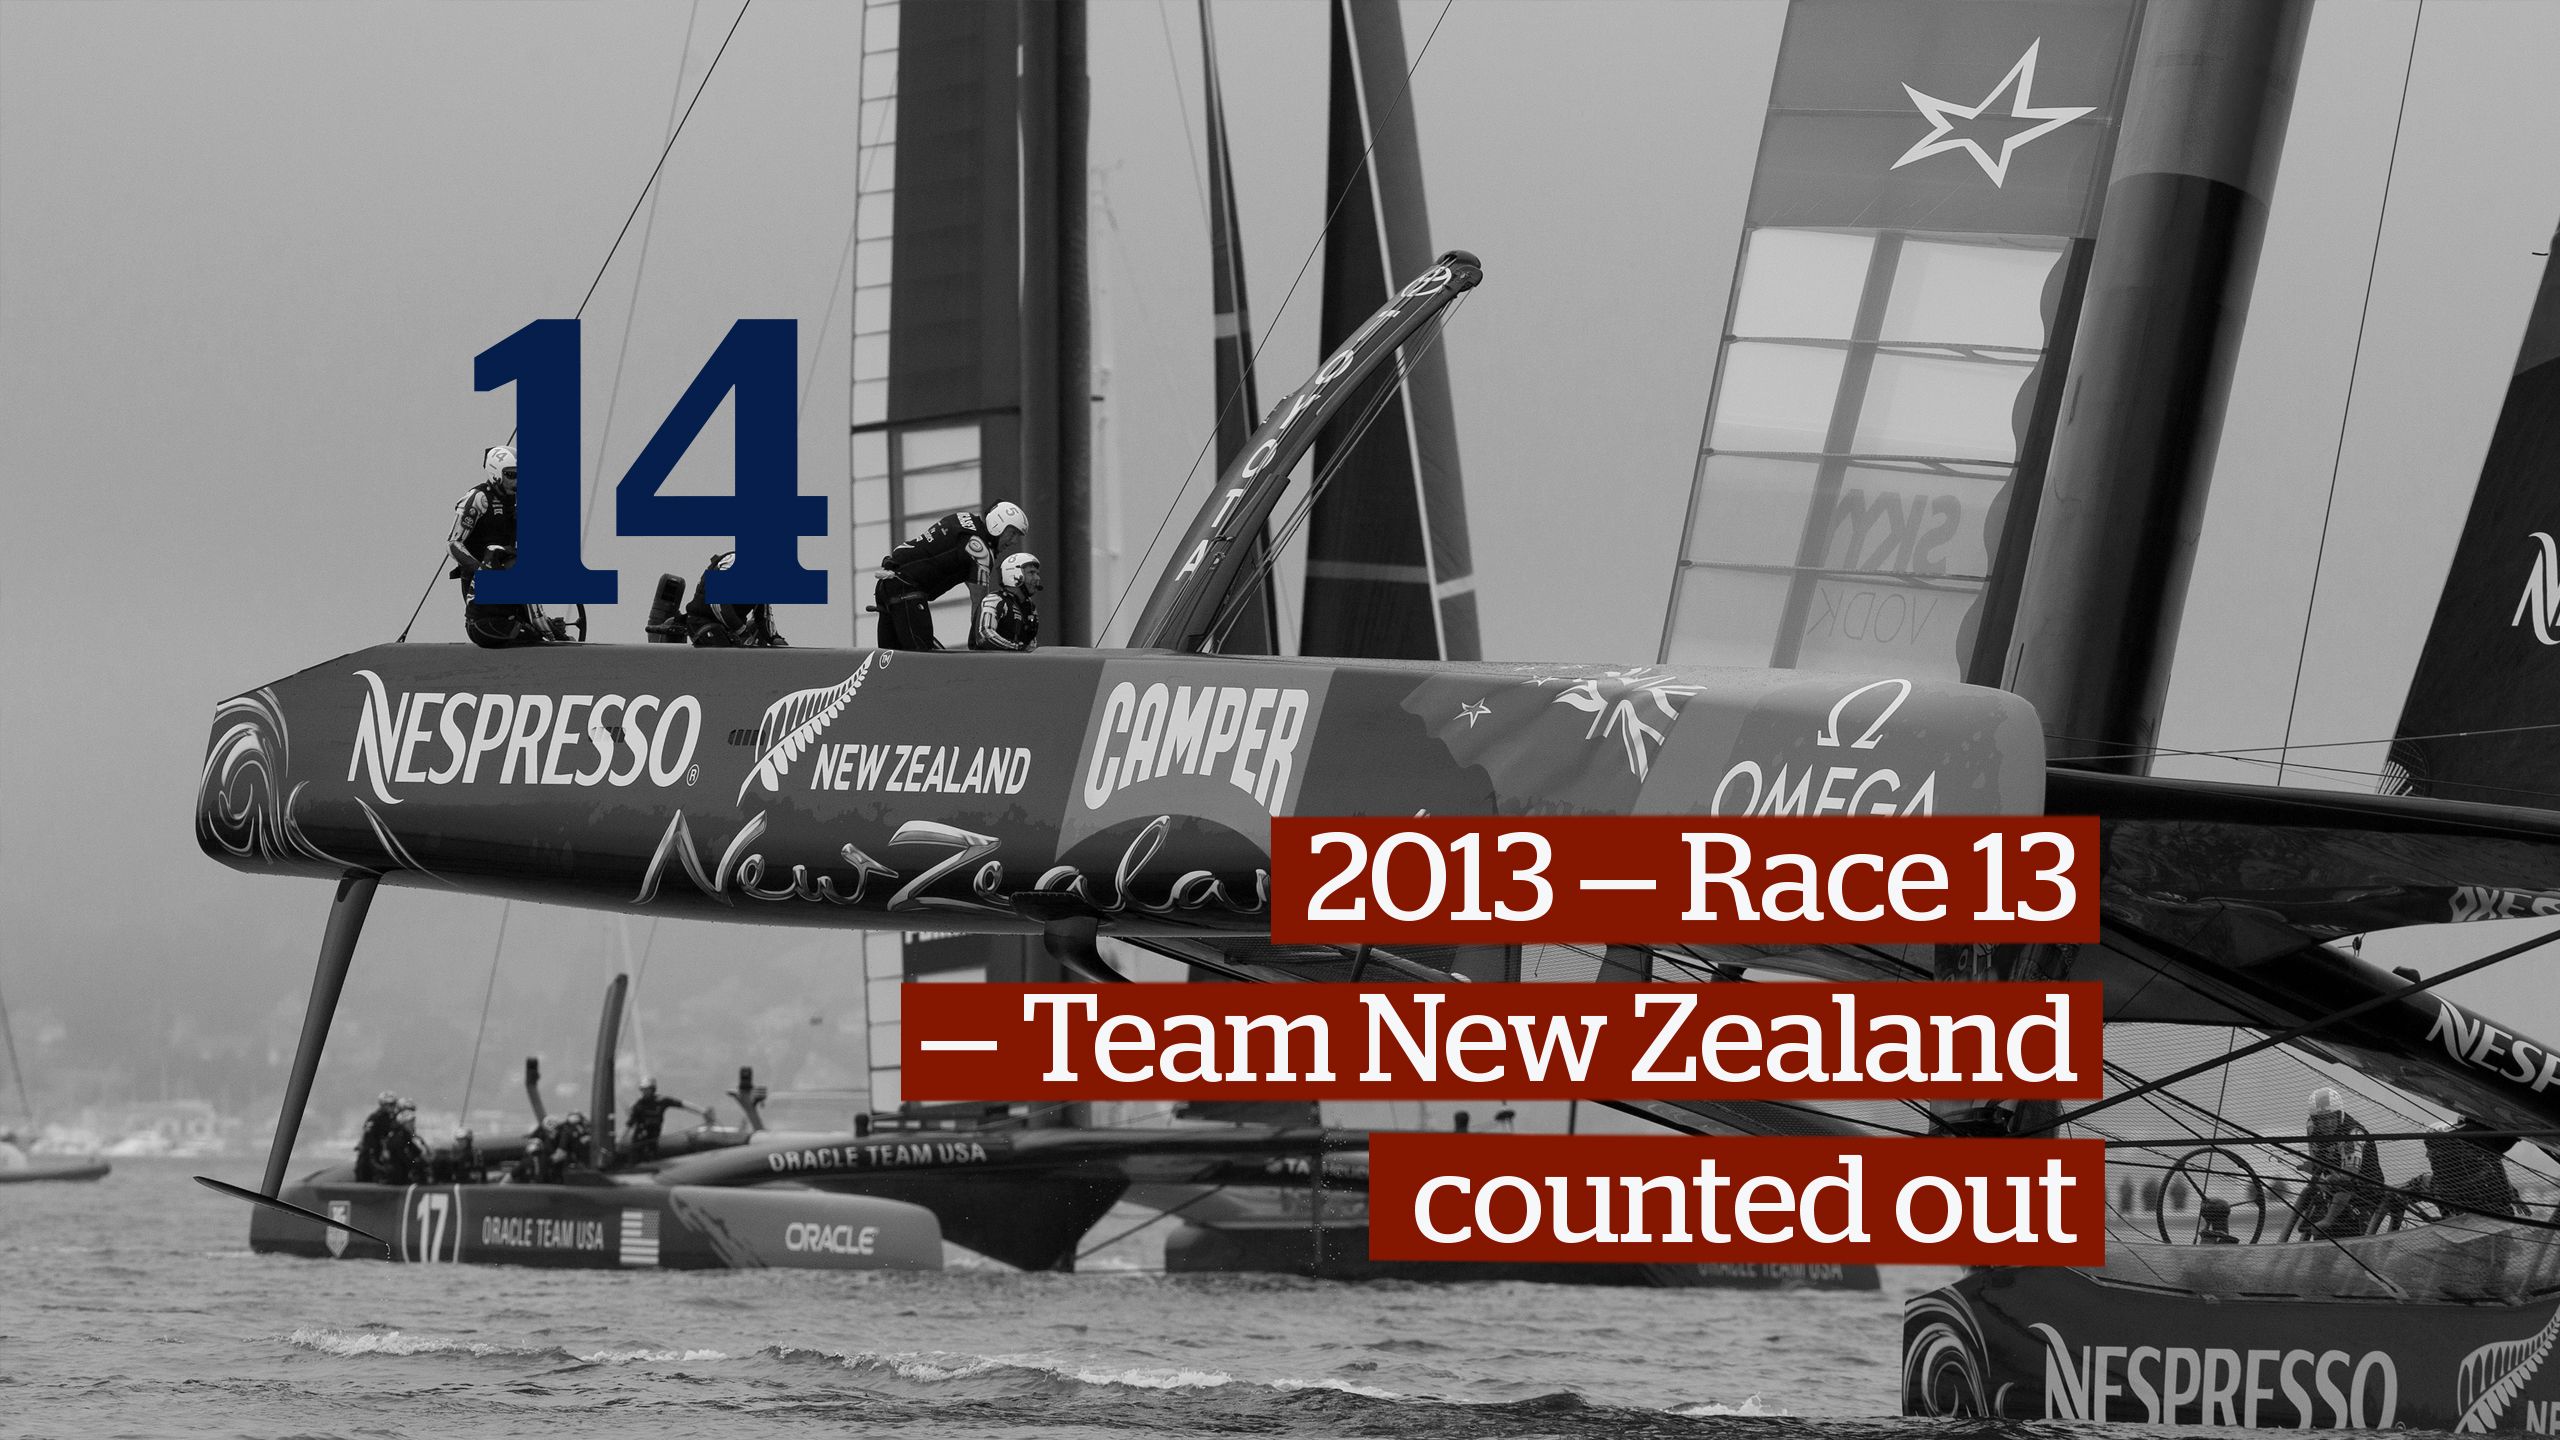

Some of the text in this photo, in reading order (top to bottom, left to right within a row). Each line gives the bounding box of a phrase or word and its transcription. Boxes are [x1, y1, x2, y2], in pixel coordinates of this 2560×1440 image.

[348, 669, 702, 804] NESPRESSO
[811, 743, 1031, 795] NEW ZEALAND
[1084, 681, 1310, 817] CAMPER
[632, 808, 1271, 914] New Zeala
[768, 1142, 988, 1172] ORACLE TEAM USA
[482, 1216, 604, 1250] ORACLE TEAM USA
[785, 1222, 879, 1255] ORACLE
[2028, 1323, 2399, 1430] NESPRESSO
